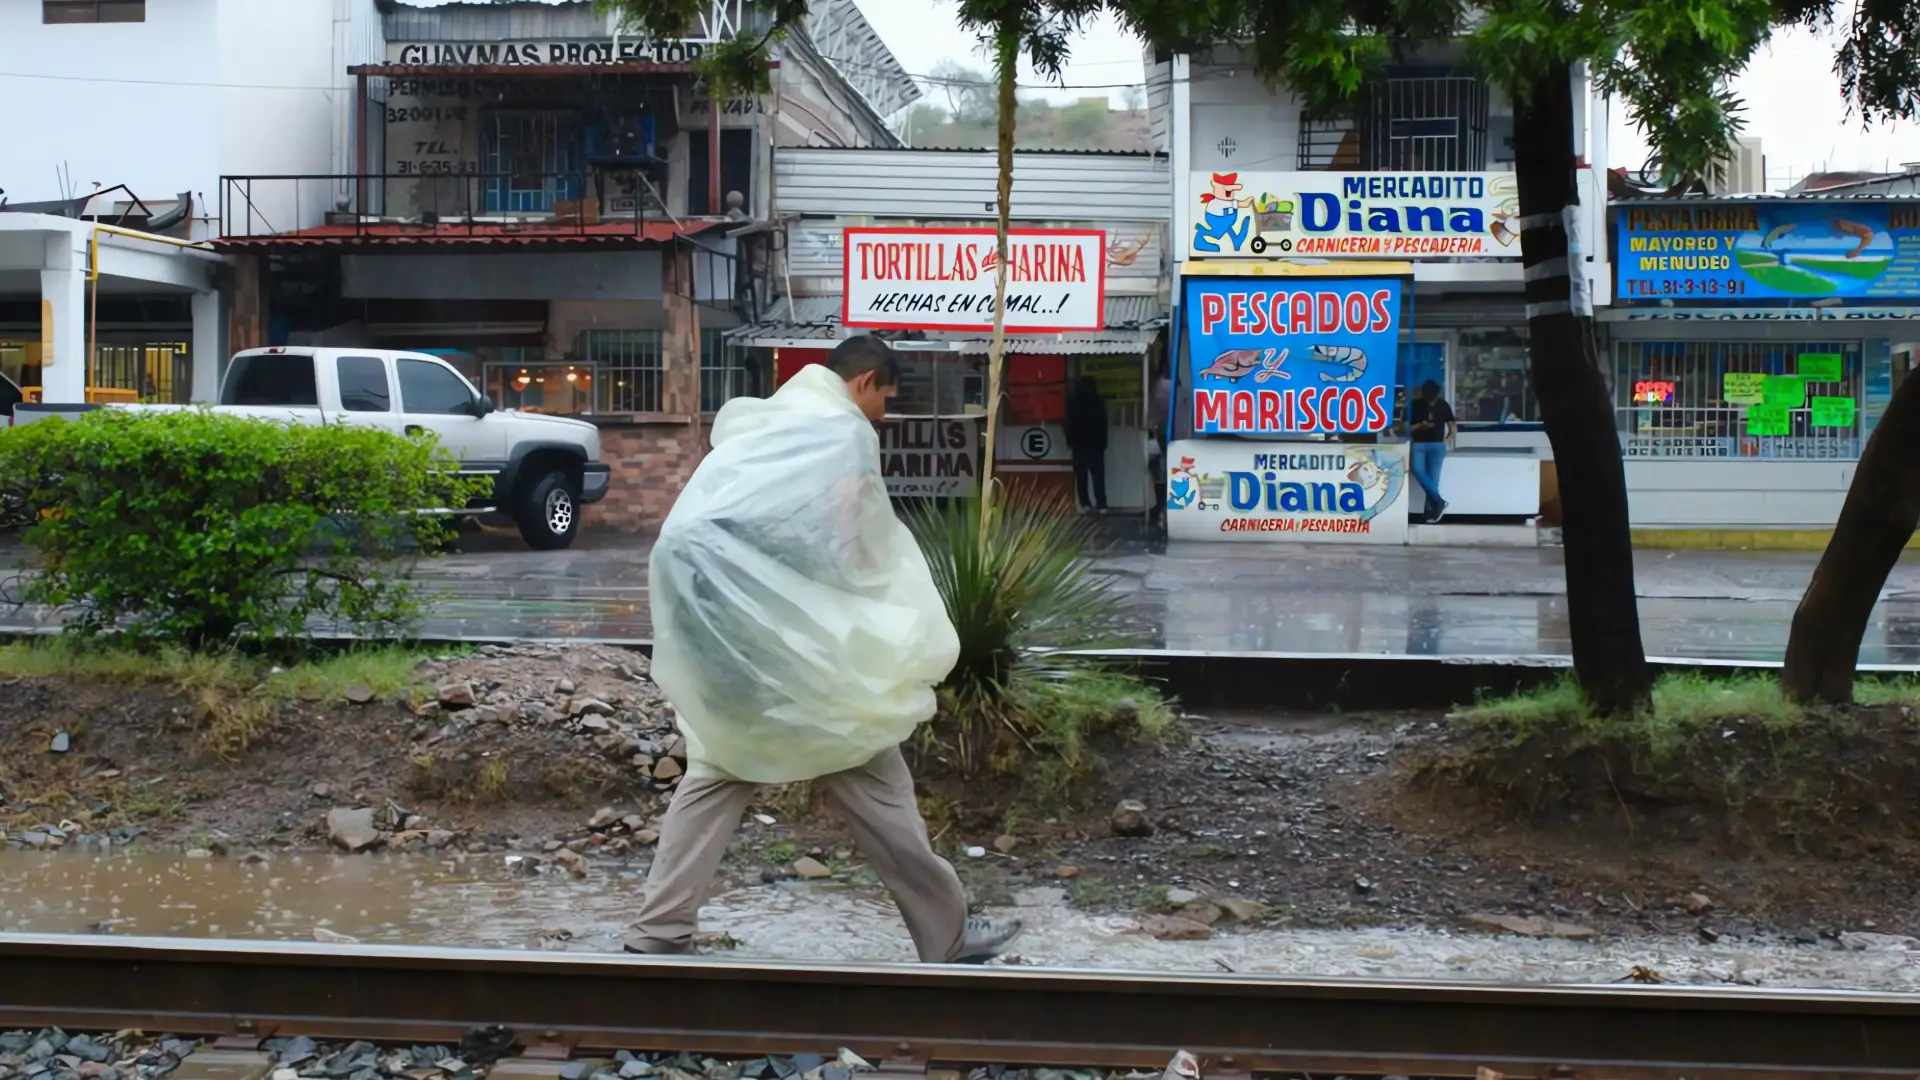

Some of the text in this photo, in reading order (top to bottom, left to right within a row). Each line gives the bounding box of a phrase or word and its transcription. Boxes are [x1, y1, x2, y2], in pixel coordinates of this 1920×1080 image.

[400, 44, 541, 65] GUAYMAS
[1344, 177, 1484, 199] MERCADITO
[1297, 192, 1485, 235] Diana
[1296, 238, 1380, 253] CARNICERIA
[1630, 236, 1735, 252] MAYOREO Y
[856, 243, 977, 281] TORTILLAS
[1002, 244, 1086, 282] HARINA
[1640, 256, 1730, 270] MENUDEO
[869, 293, 944, 312] HECHAS
[948, 294, 976, 312] EN
[1201, 290, 1391, 335] PESCADOS
[1194, 386, 1388, 432] MARISCOS
[1029, 435, 1044, 453] E
[1254, 454, 1345, 470] MERCADITO
[1224, 471, 1365, 513] Diana
[1220, 518, 1295, 533] CARNICERIA
[1301, 518, 1370, 534] PESCADERIA
